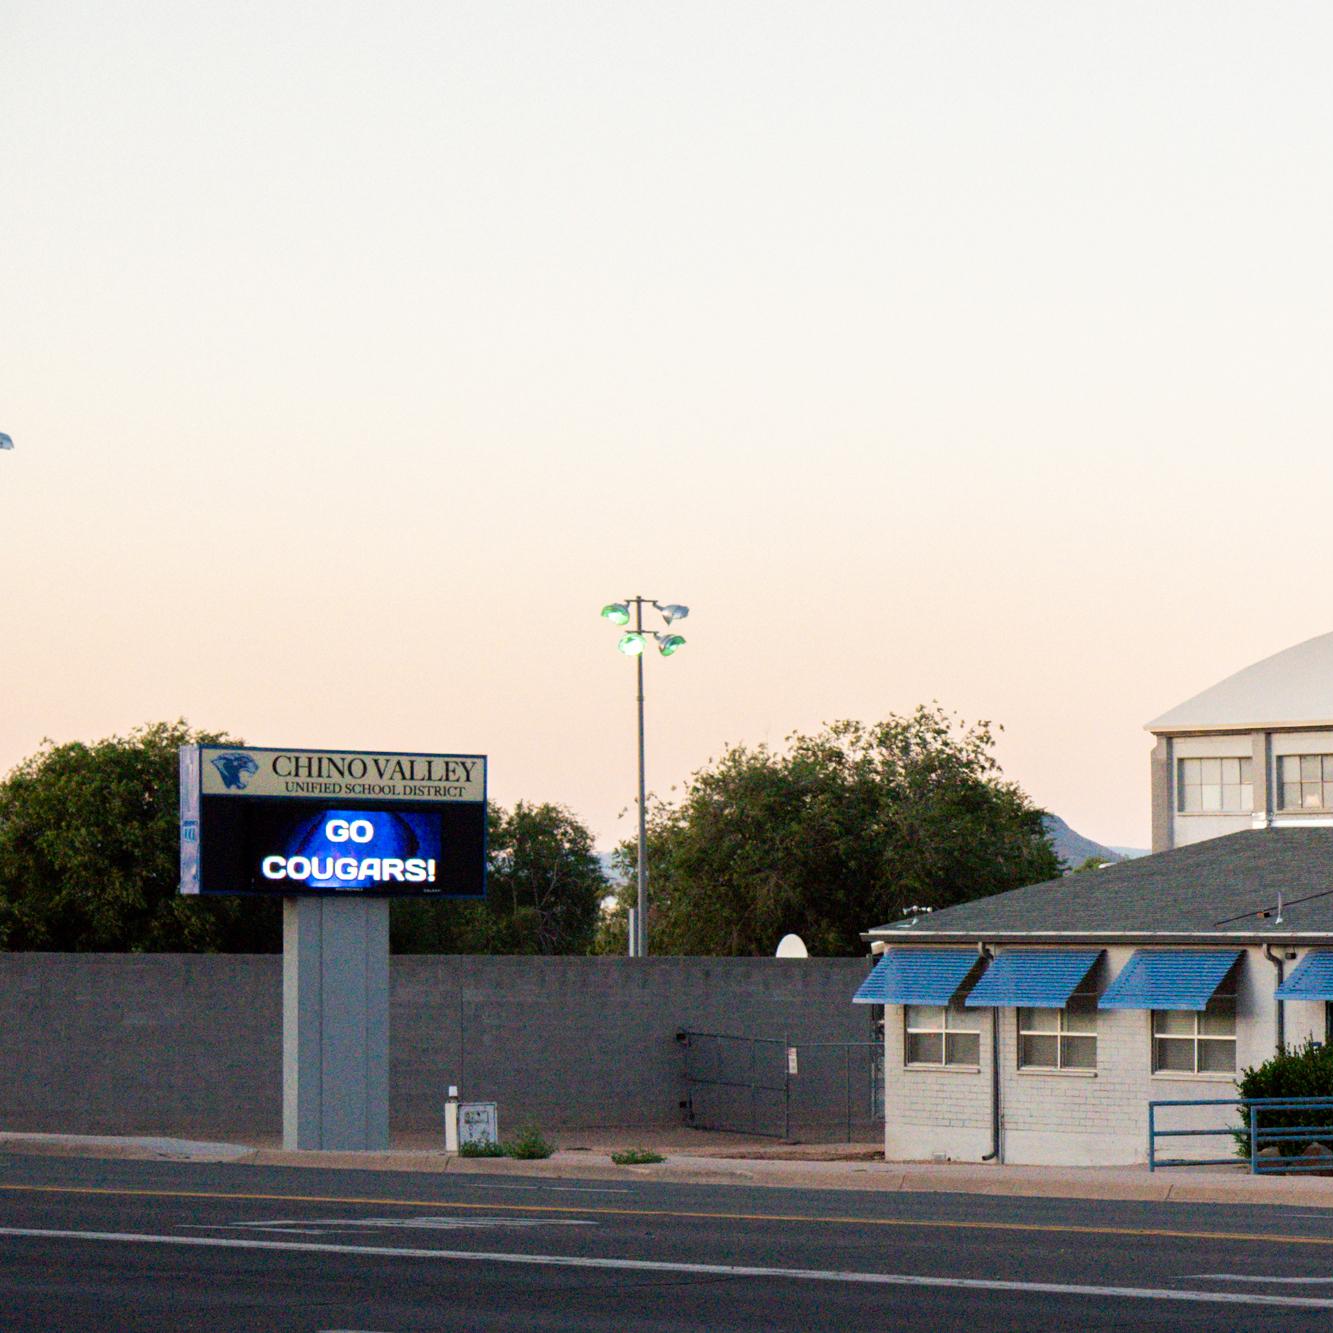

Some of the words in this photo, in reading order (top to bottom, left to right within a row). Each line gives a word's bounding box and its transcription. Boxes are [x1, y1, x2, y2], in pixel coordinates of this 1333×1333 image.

[272, 755, 368, 779] CHINO
[373, 757, 477, 783] VALLEY
[285, 781, 342, 794] UNIFIED
[344, 783, 400, 796] SCHOOL
[403, 784, 466, 797] DISTRICT
[327, 819, 374, 843] GO
[262, 855, 436, 882] COUGARS!
